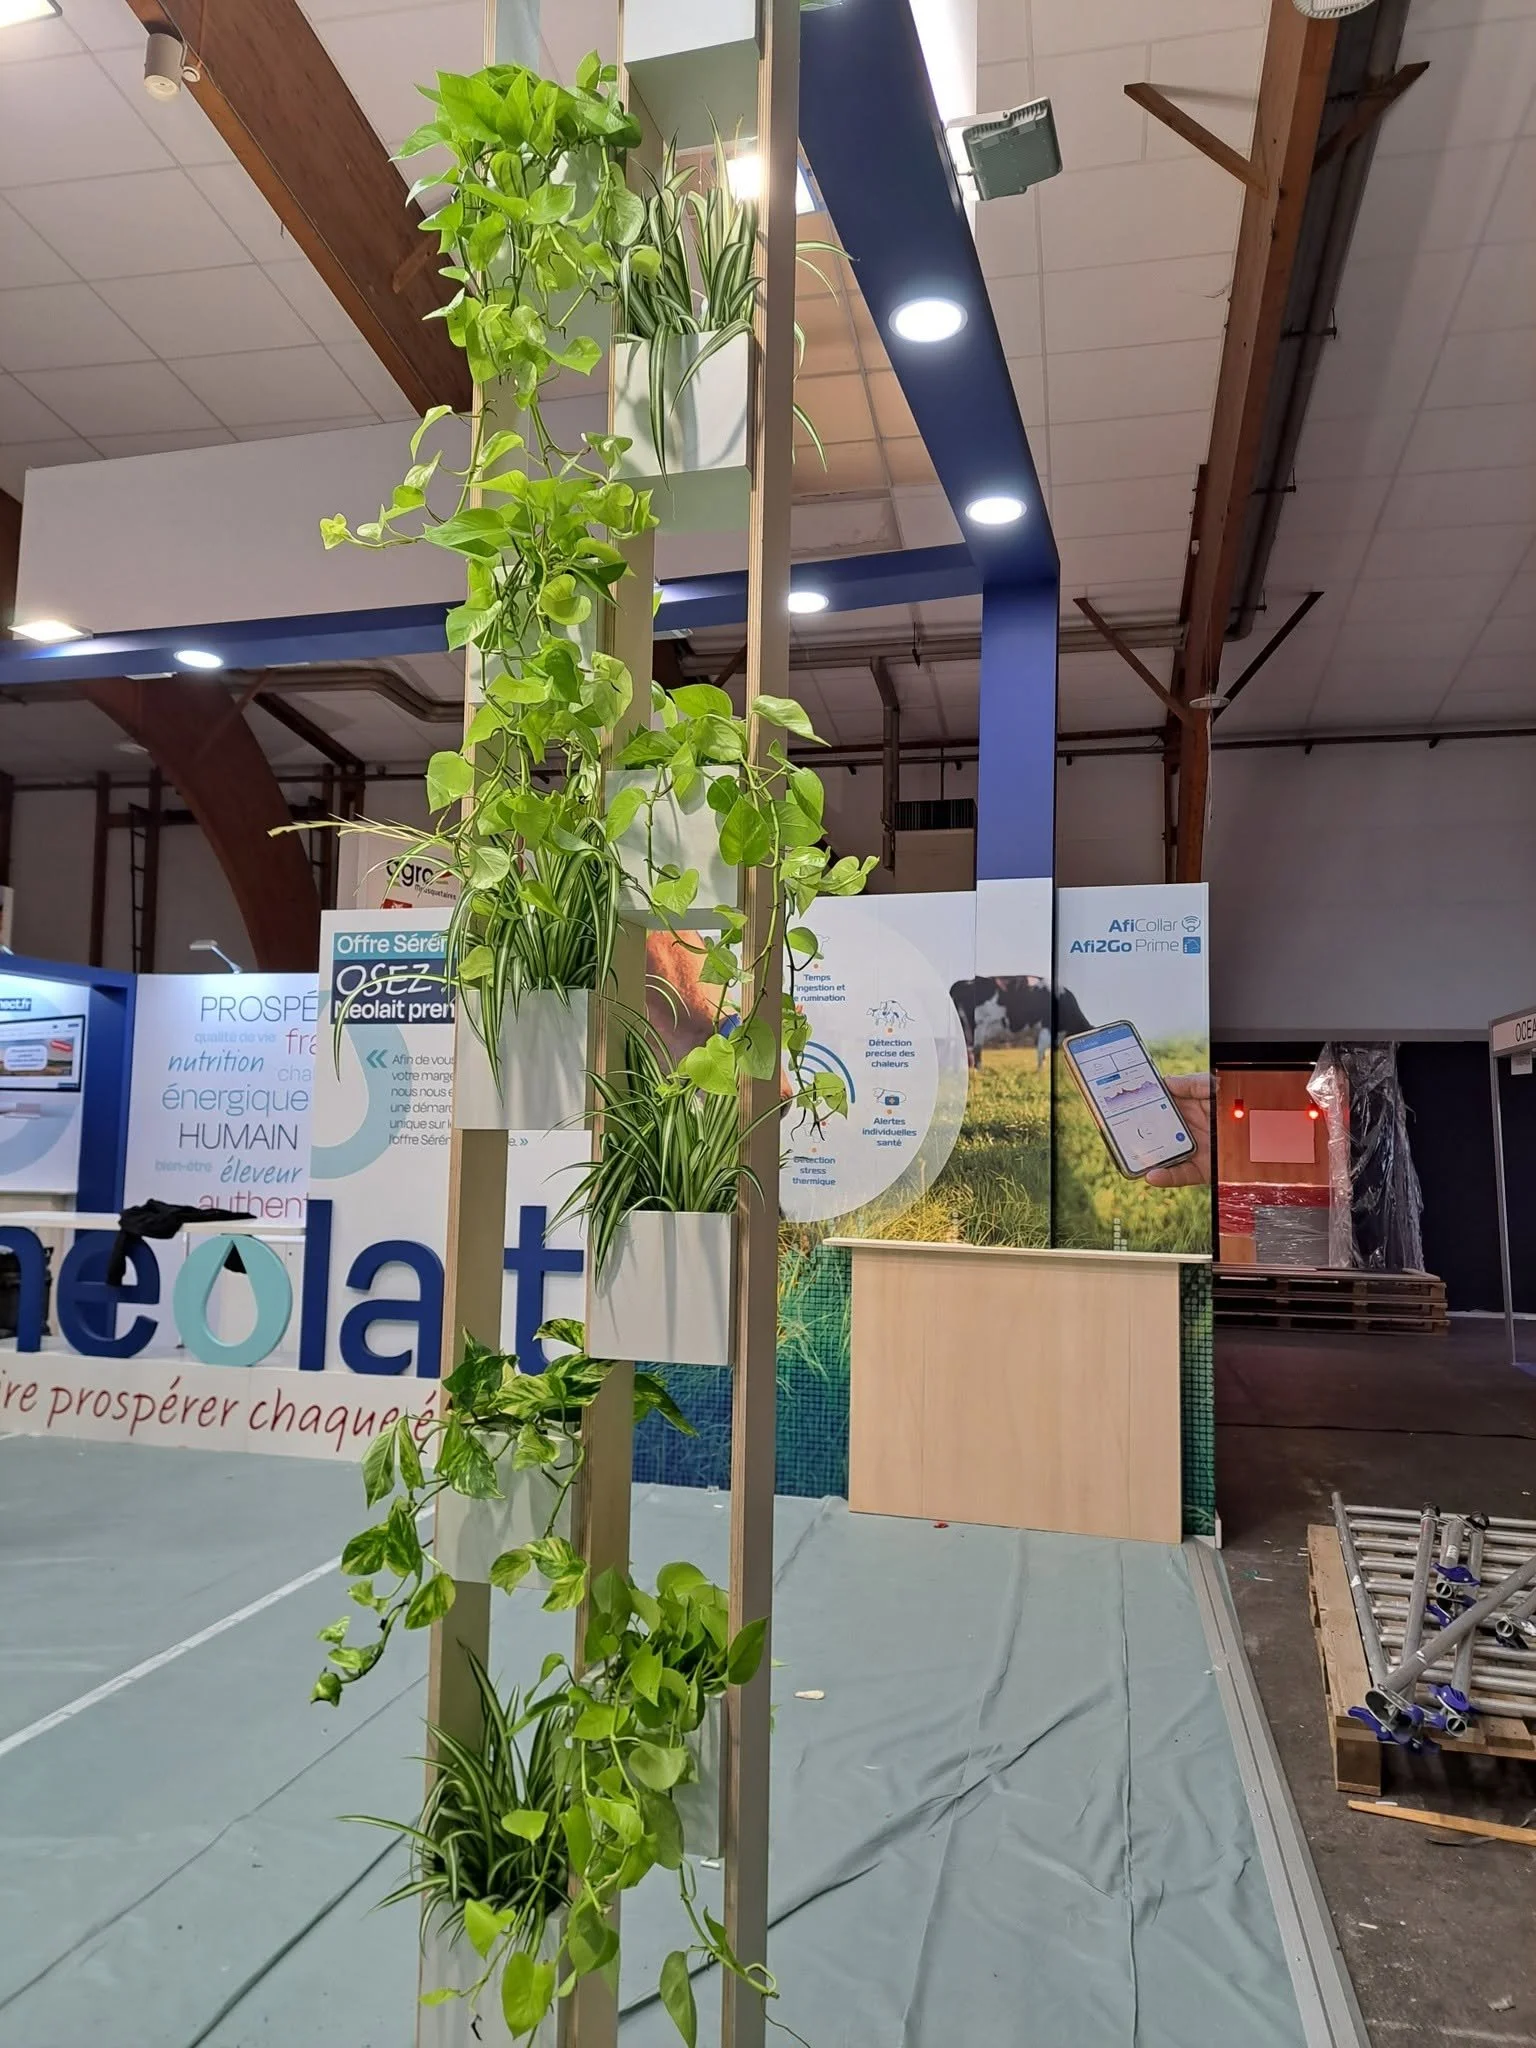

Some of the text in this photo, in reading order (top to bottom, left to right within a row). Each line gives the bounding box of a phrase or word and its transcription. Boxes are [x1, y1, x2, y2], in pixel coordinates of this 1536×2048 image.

[1108, 918, 1178, 932] AfiCollar
[337, 934, 389, 954] Offre
[1069, 938, 1179, 953] Afi2Go Prime
[336, 962, 432, 996] OSEZ
[803, 974, 831, 982] Temps
[334, 1000, 401, 1020] Neolait
[868, 1039, 912, 1047] Détection
[898, 1048, 915, 1057] des
[167, 1049, 265, 1073] nutrition
[392, 1054, 413, 1065] Afin
[415, 1055, 429, 1065] de
[392, 1071, 419, 1081] votre
[390, 1087, 417, 1097] nous
[419, 1088, 450, 1098] nous
[162, 1083, 310, 1117] énergique
[390, 1104, 411, 1113] une
[389, 1119, 427, 1131] unique
[428, 1120, 447, 1129] sur
[873, 1117, 906, 1126] Alertes
[179, 1122, 298, 1151] HUMAIN
[862, 1128, 917, 1137] individuelles
[876, 1139, 902, 1147] santé
[220, 1155, 303, 1184] éleveur
[799, 1166, 827, 1175] stress
[792, 1177, 836, 1186] thermique
[0, 1200, 584, 1378] neolat
[47, 1376, 239, 1437] prospérer
[249, 1388, 399, 1452] chaque
